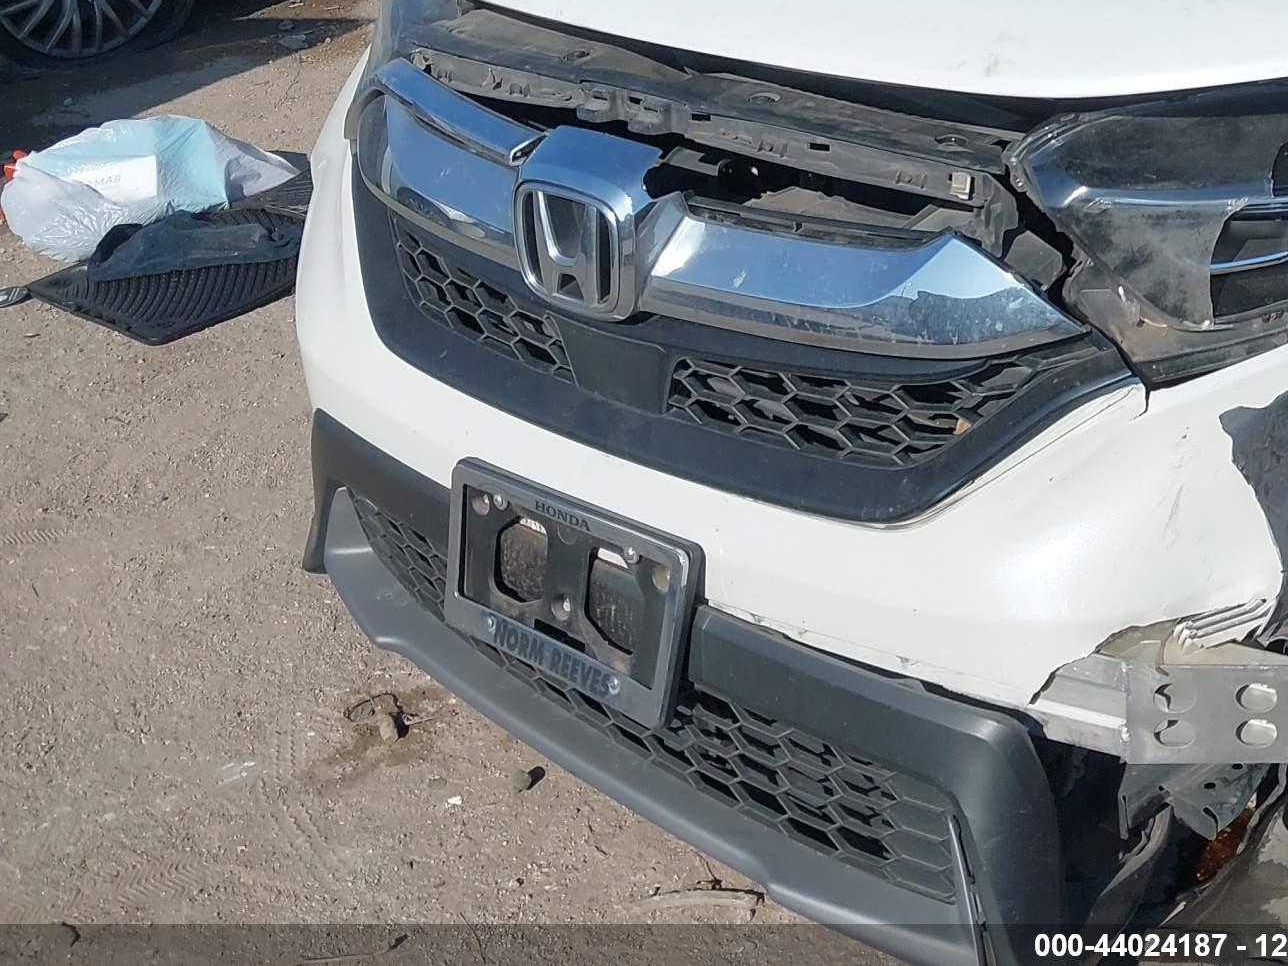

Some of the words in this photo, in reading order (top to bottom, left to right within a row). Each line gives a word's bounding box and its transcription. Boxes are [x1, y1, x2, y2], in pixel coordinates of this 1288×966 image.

[535, 500, 591, 532] HONDA
[494, 621, 545, 666] NORM
[550, 646, 610, 698] REEVES
